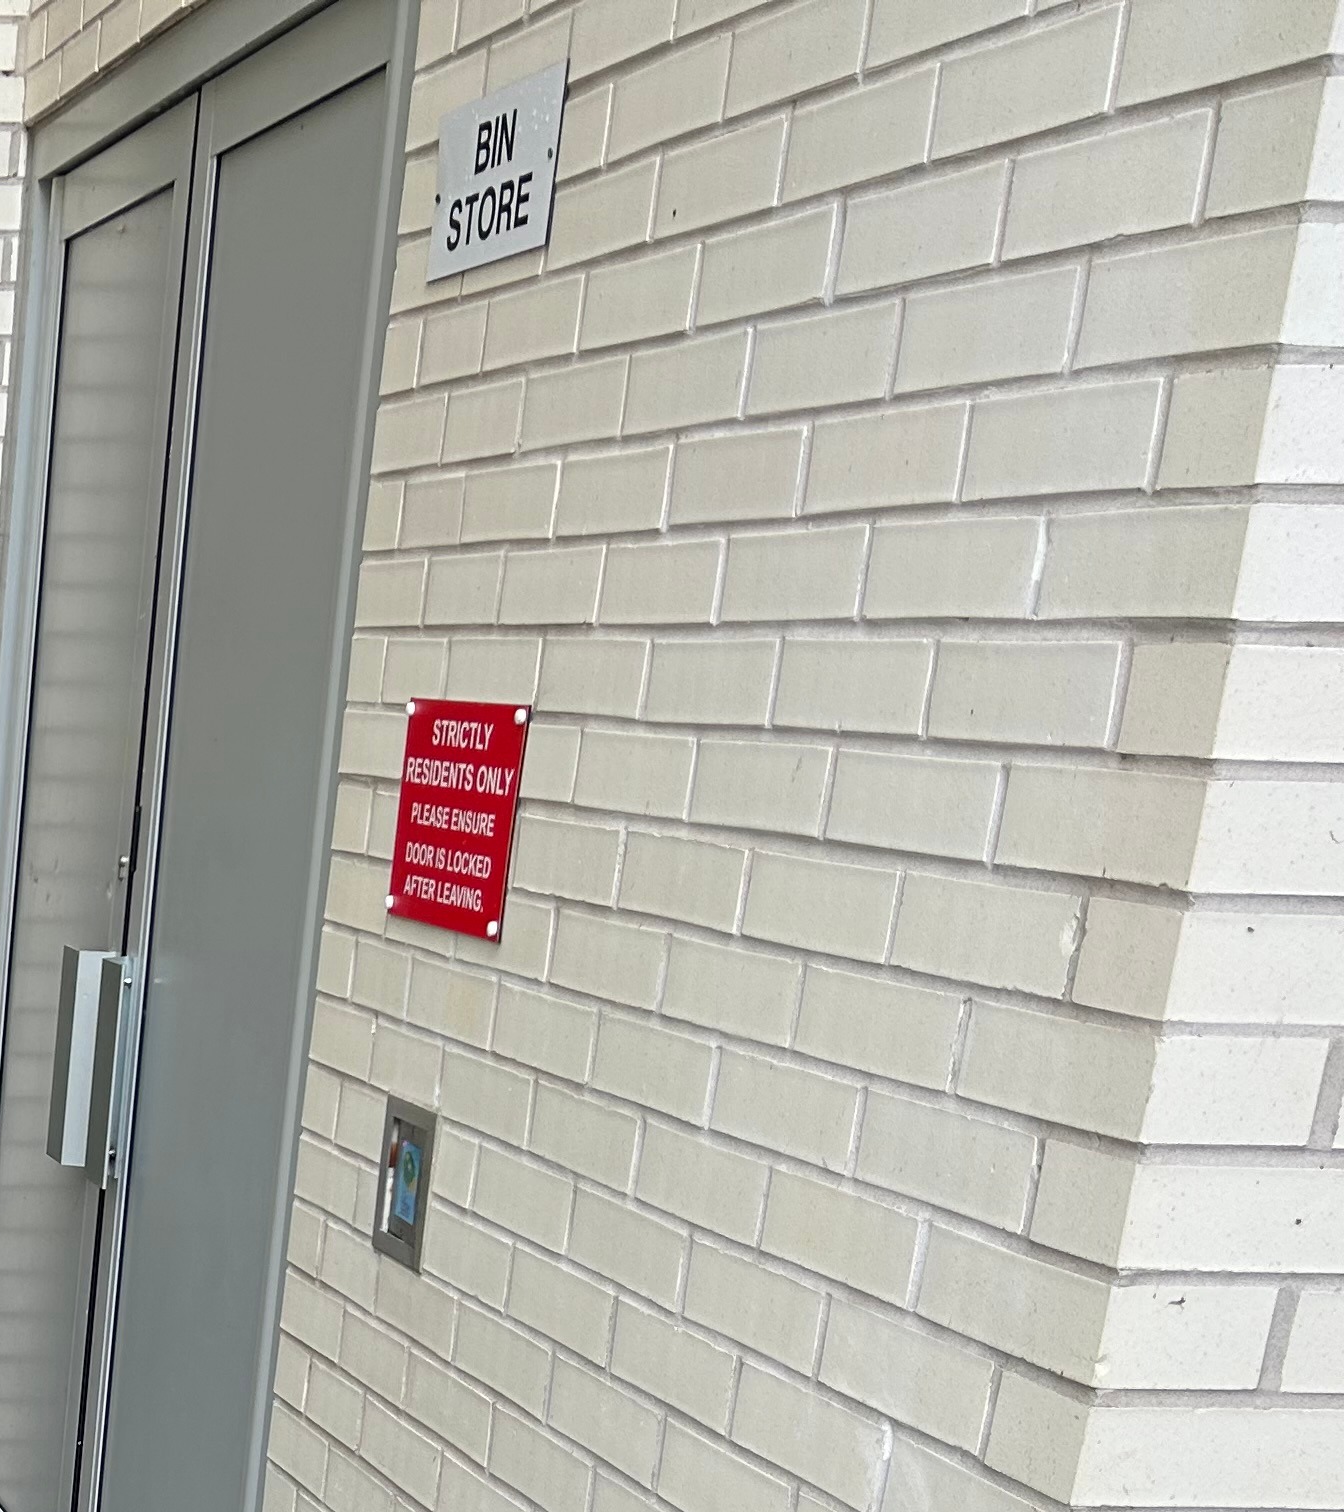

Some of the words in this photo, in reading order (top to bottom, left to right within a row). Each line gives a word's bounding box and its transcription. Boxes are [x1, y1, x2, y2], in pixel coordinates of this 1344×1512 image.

[474, 108, 518, 176] BIN
[446, 171, 534, 252] STORE
[431, 718, 494, 751] STRICTLY
[405, 756, 474, 792] RESIDENTS
[476, 765, 515, 797] ONLY
[410, 801, 451, 830] PLEASE
[451, 809, 496, 838] ENSURE
[405, 841, 434, 866] DOOR
[435, 848, 446, 871] IS
[445, 849, 492, 880] LOCKED
[403, 874, 434, 901] AFTER
[436, 883, 484, 913] LEAVING.
